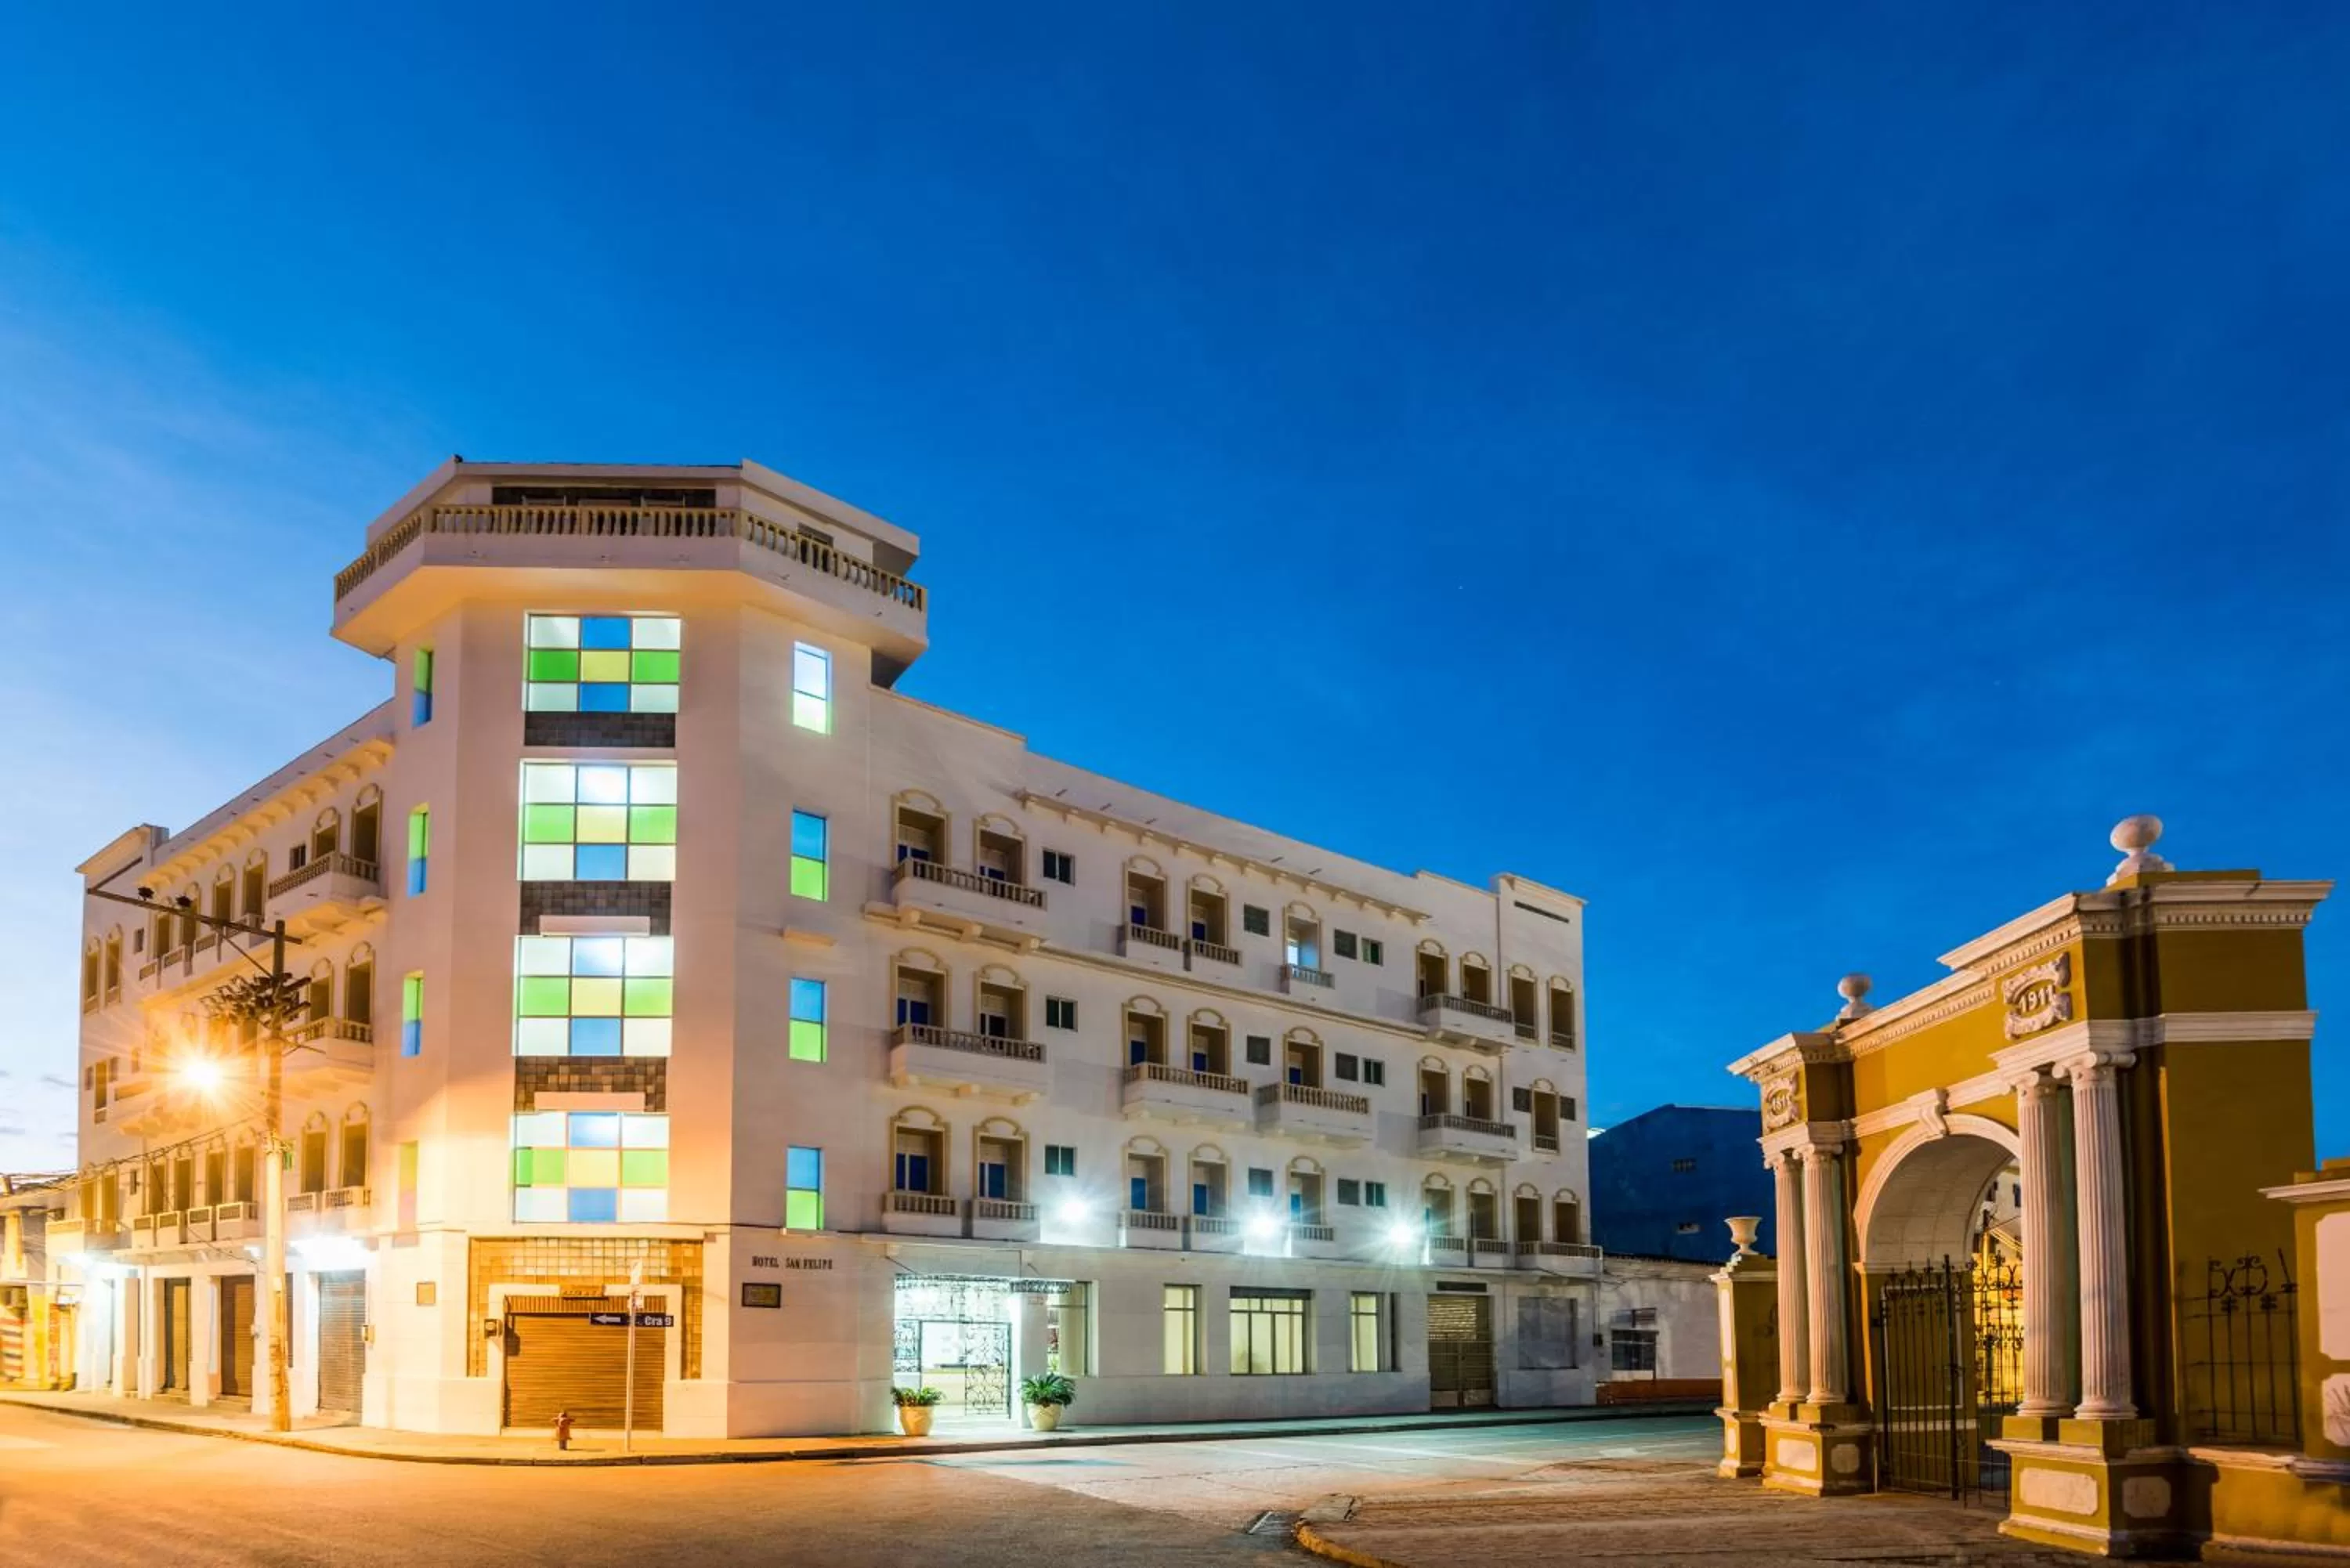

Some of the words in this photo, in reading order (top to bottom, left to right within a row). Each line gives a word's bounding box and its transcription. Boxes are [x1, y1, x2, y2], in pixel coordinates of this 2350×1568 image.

[2019, 985, 2055, 1013] 1911
[752, 1255, 779, 1268] HOTEL
[786, 1257, 800, 1269] SAN
[803, 1259, 832, 1270] FELIPE
[645, 1316, 663, 1325] Cra
